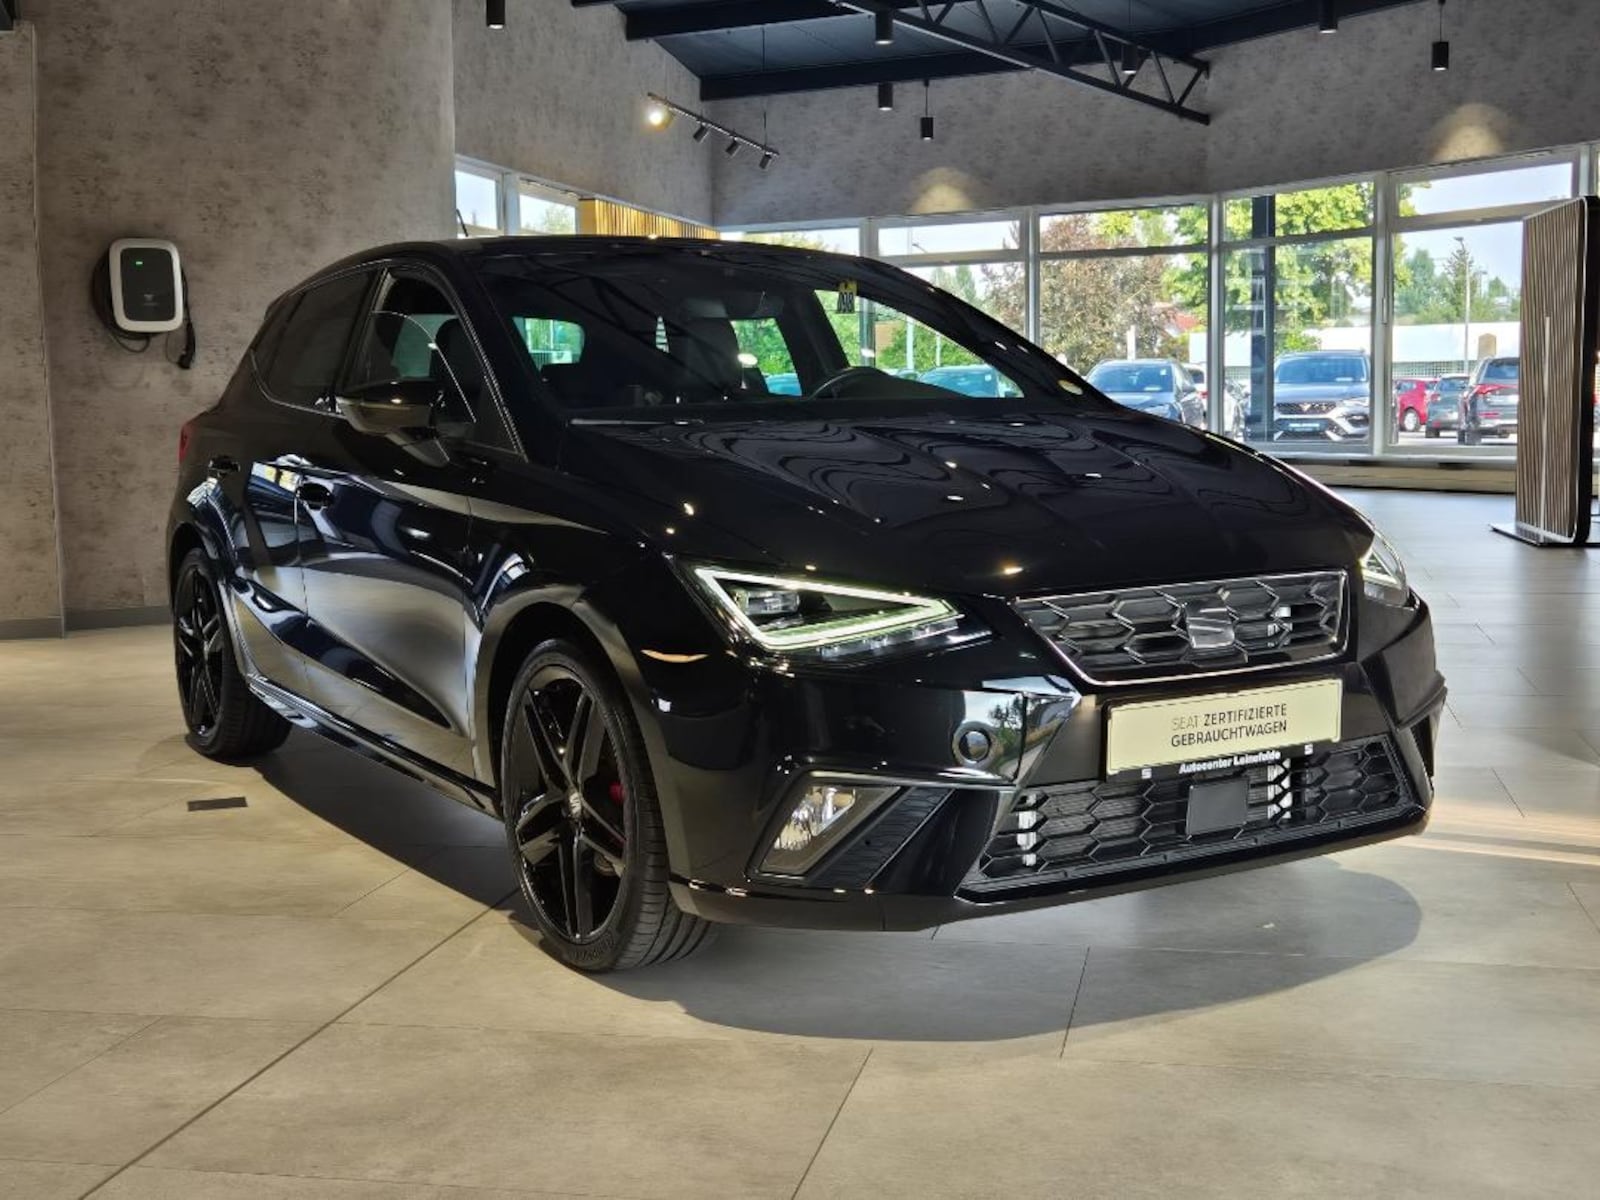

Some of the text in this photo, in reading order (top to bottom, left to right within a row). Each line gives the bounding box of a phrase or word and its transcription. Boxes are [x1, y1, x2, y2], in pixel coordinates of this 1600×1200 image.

[1171, 703, 1287, 731] SEAT ZERTIFIZIERTE
[1171, 719, 1287, 747] GEBRAUCHTWAGEN
[1179, 757, 1233, 775] Autocenter
